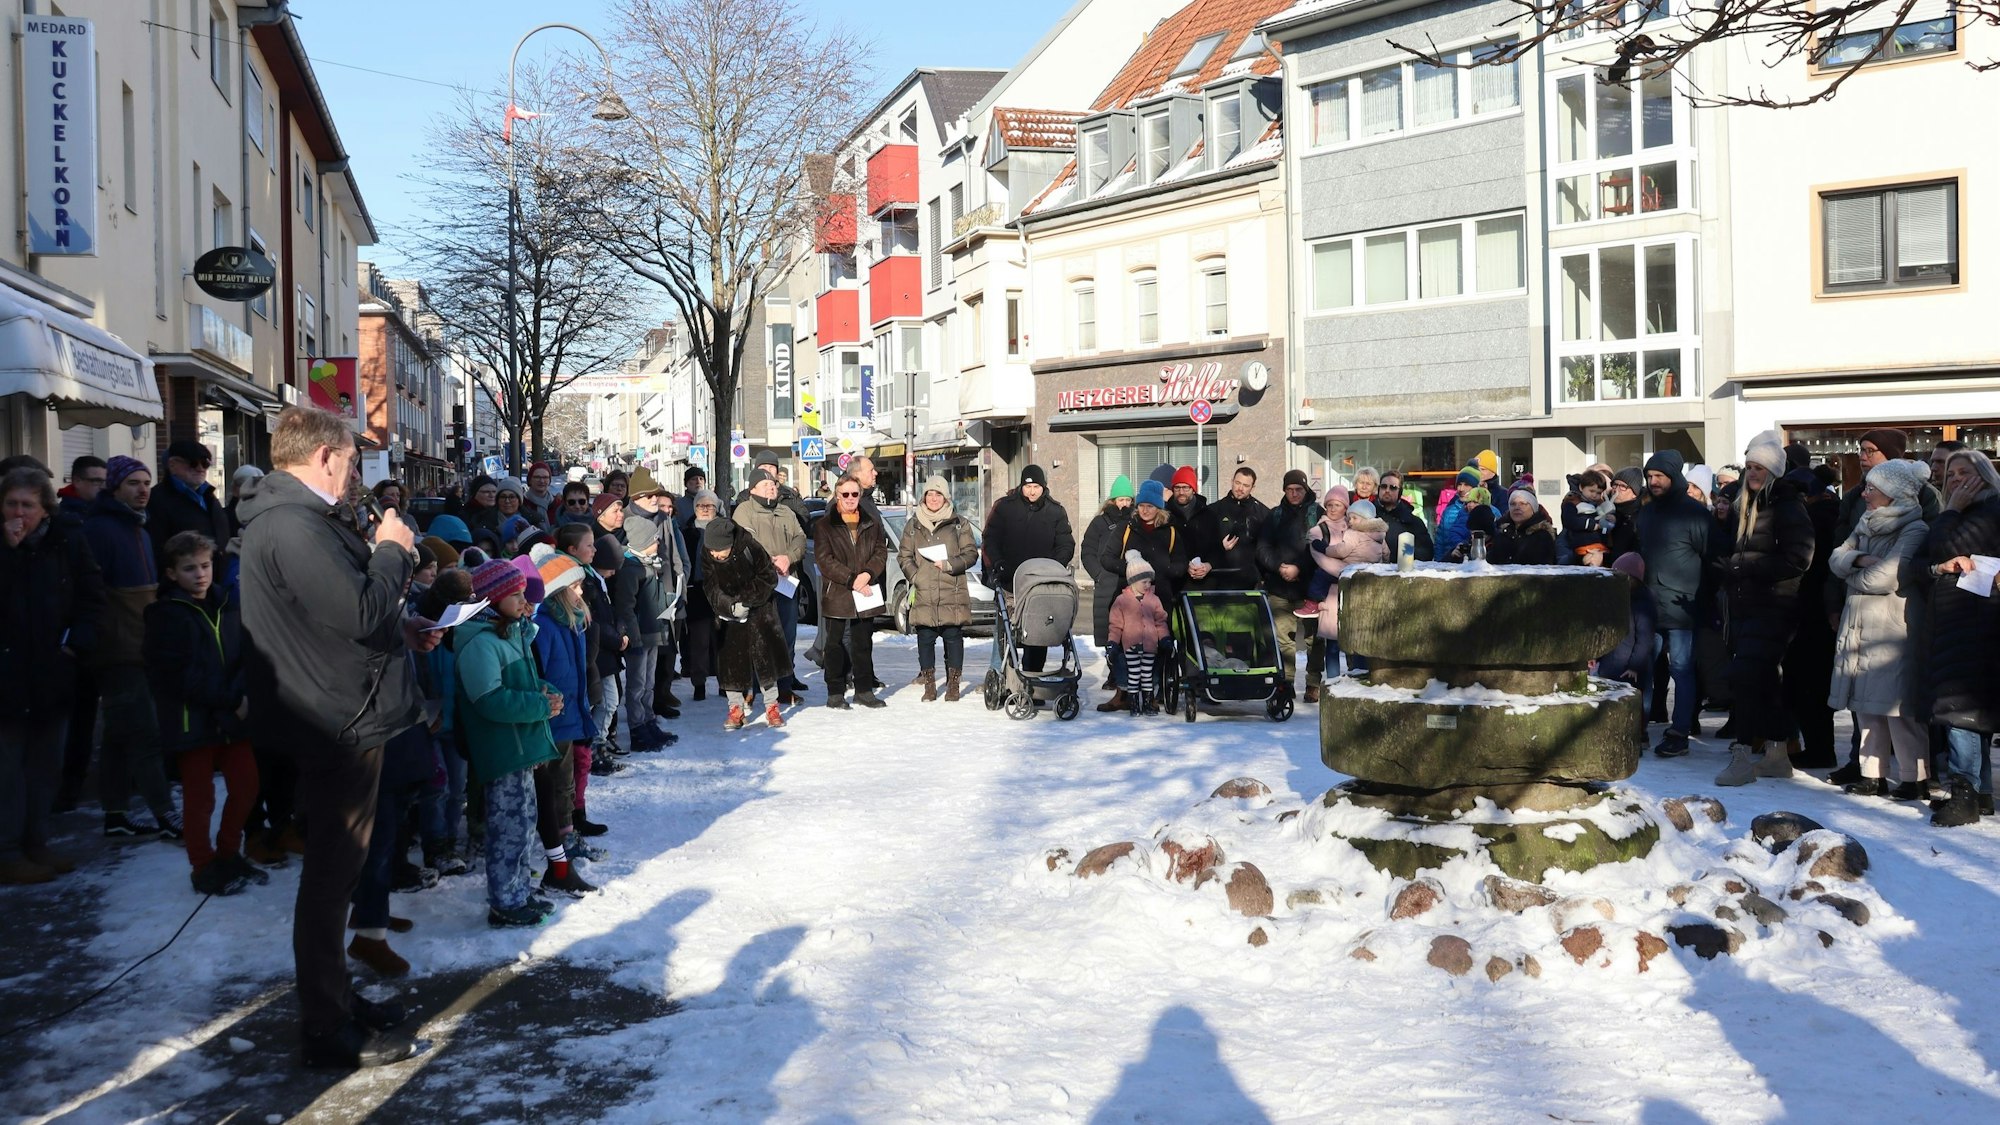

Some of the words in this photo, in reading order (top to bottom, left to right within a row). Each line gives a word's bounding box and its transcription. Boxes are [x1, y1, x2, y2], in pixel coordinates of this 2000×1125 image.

[27, 21, 86, 35] MEDARD
[52, 40, 71, 247] KUCKELKORN
[198, 272, 214, 281] MIN
[216, 273, 246, 283] BEAUTY
[248, 275, 271, 284] NAILS
[69, 340, 134, 389] Bestattungshaus
[775, 343, 791, 399] KIND
[1057, 385, 1158, 410] METZGEREI
[1158, 361, 1239, 403] Höller
